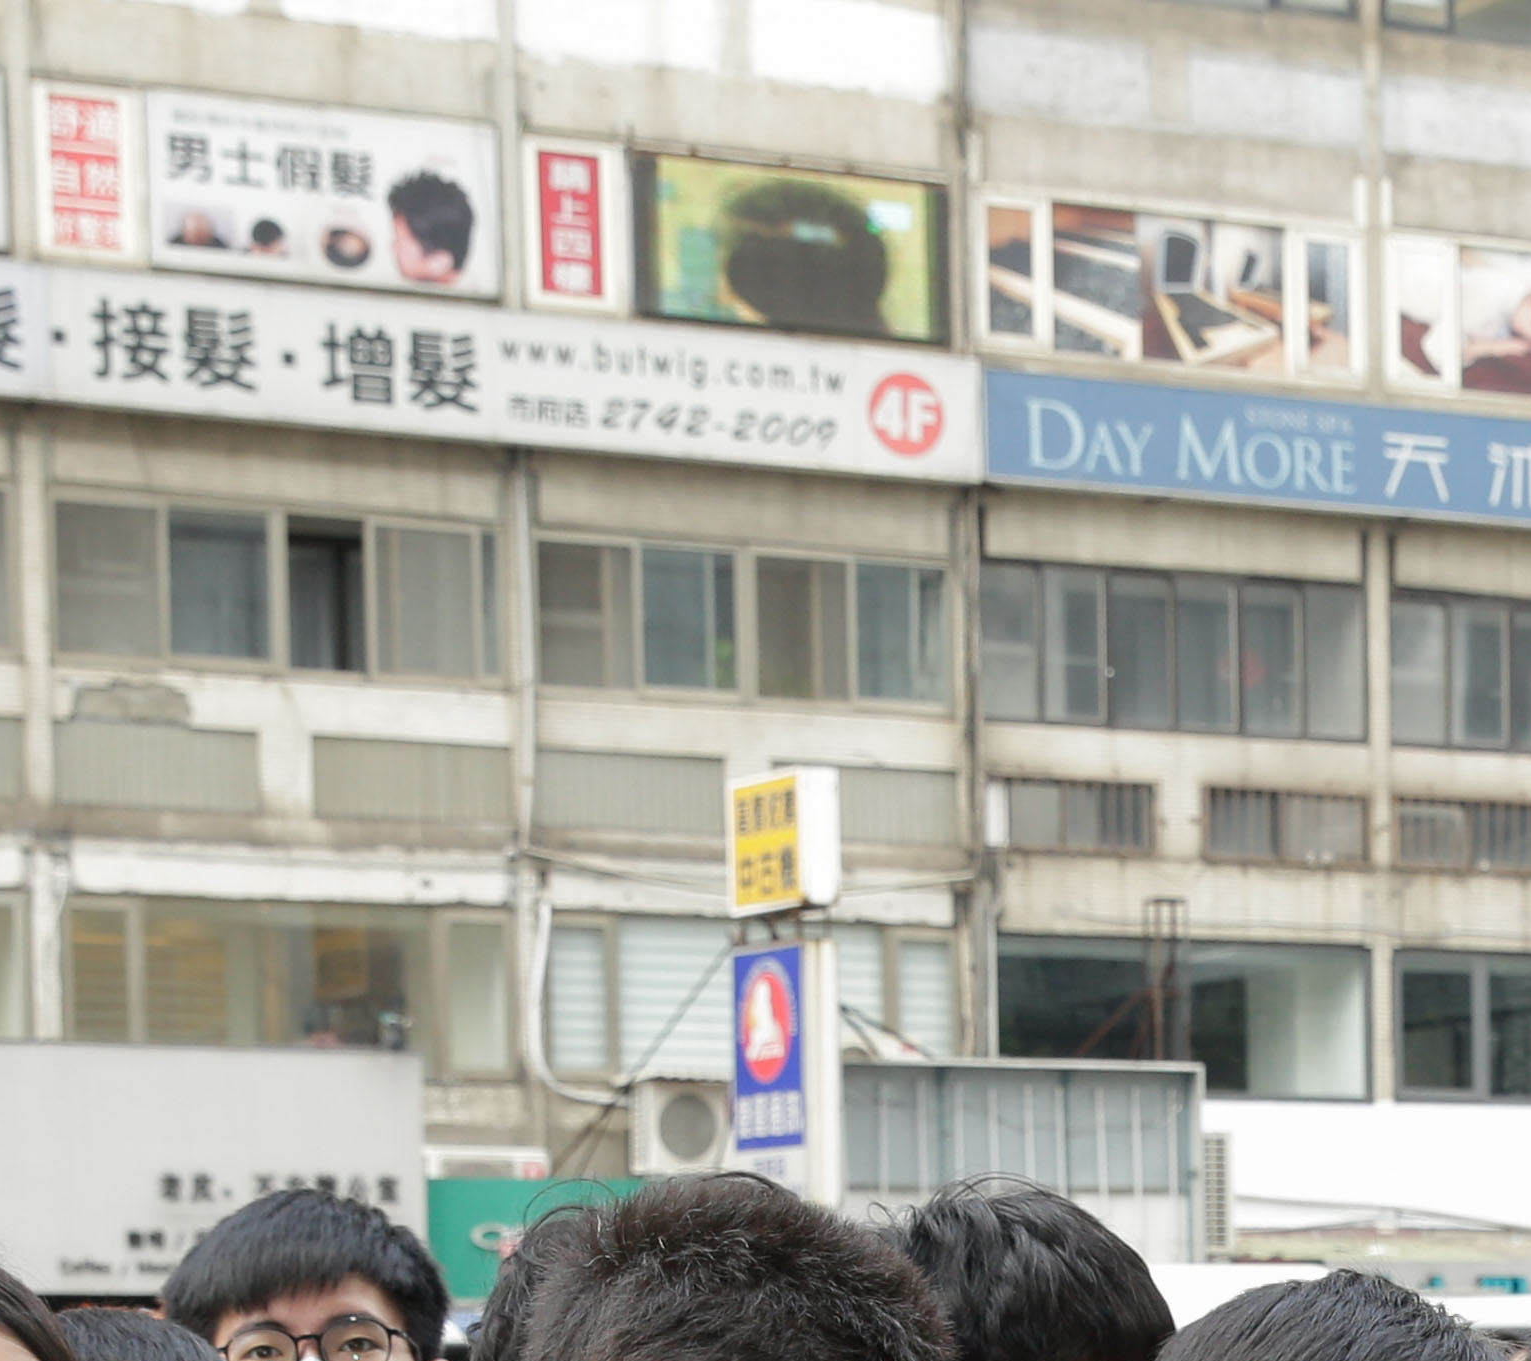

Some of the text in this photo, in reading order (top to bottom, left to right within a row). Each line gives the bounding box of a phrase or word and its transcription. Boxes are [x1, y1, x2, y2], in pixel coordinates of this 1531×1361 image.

[167, 134, 374, 197] 男士假髮
[600, 398, 837, 452] 2742-2009
[874, 388, 938, 444] 4F
[1026, 400, 1357, 495] DAY MORE
